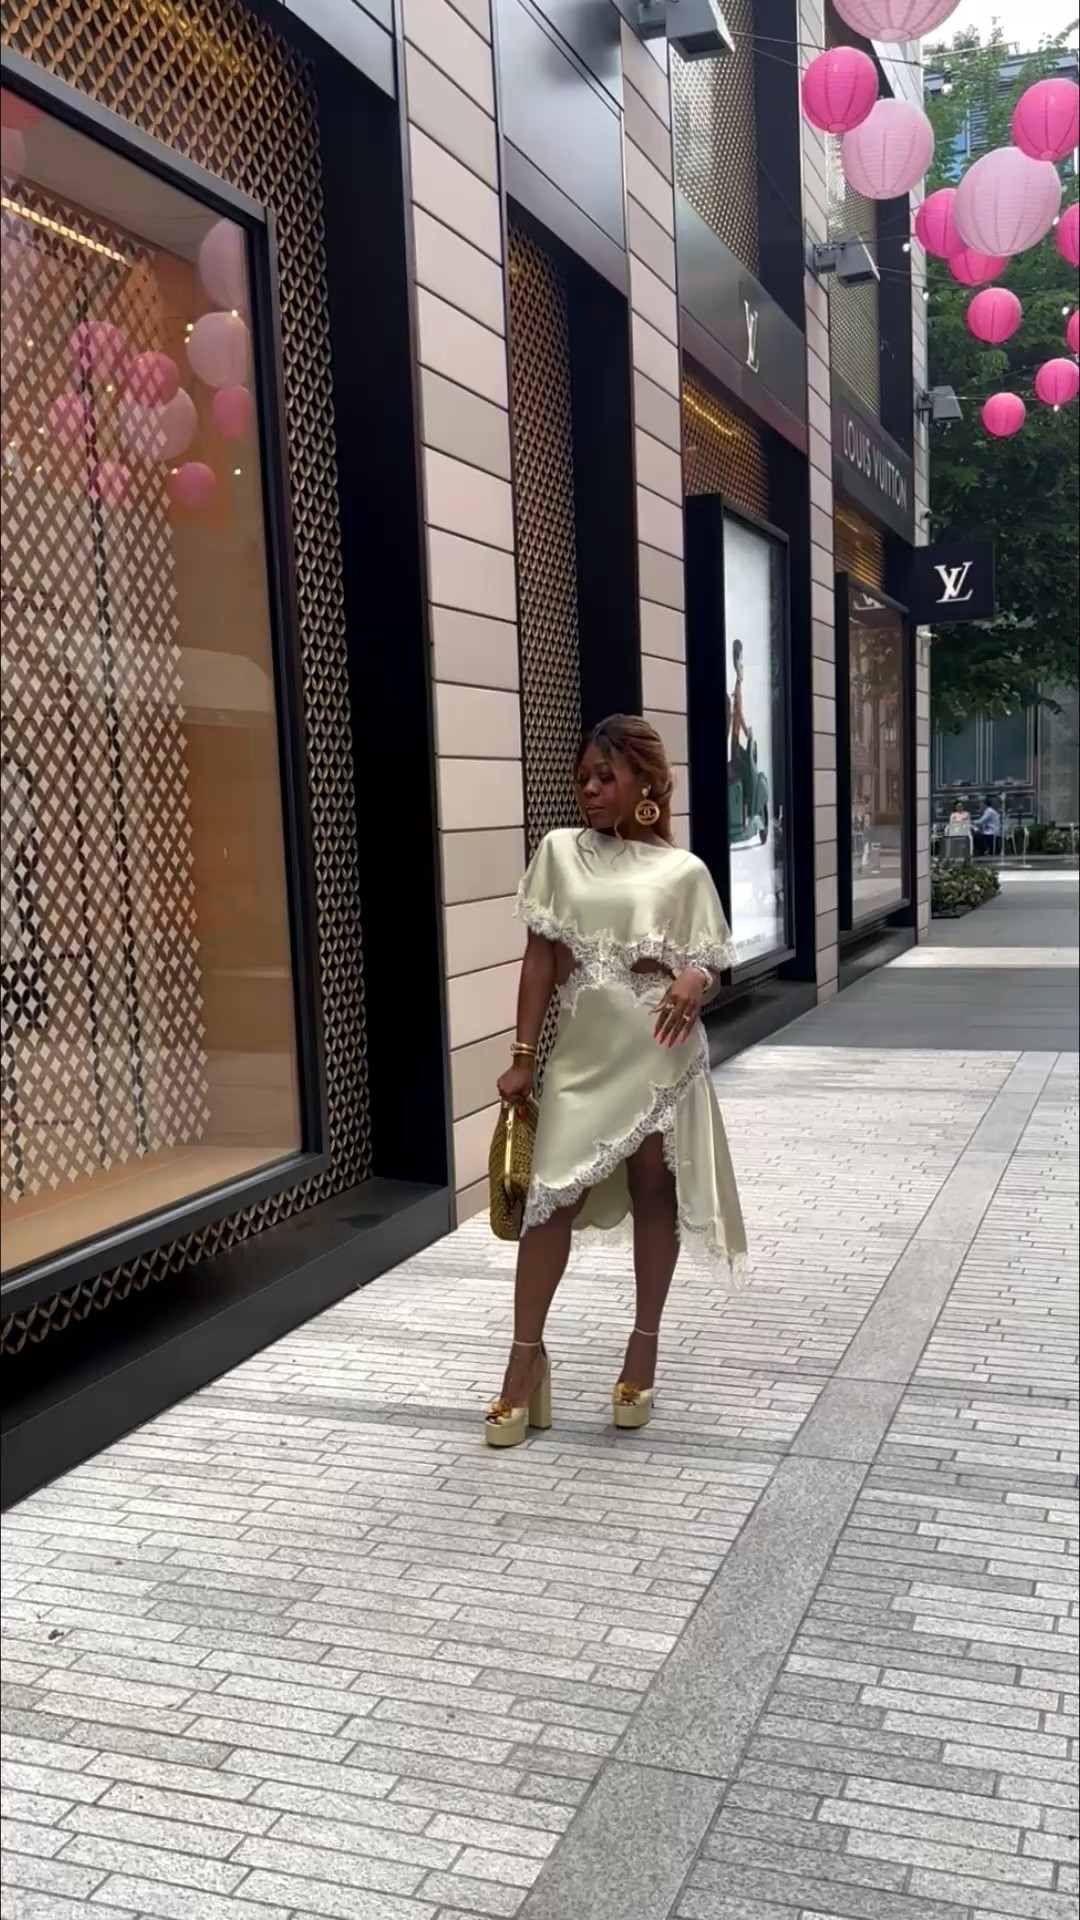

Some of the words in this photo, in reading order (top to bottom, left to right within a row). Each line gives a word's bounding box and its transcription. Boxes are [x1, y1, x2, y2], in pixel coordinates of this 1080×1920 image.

[842, 414, 872, 478] LOUIS
[872, 444, 907, 513] VUITTON
[933, 561, 974, 603] LV
